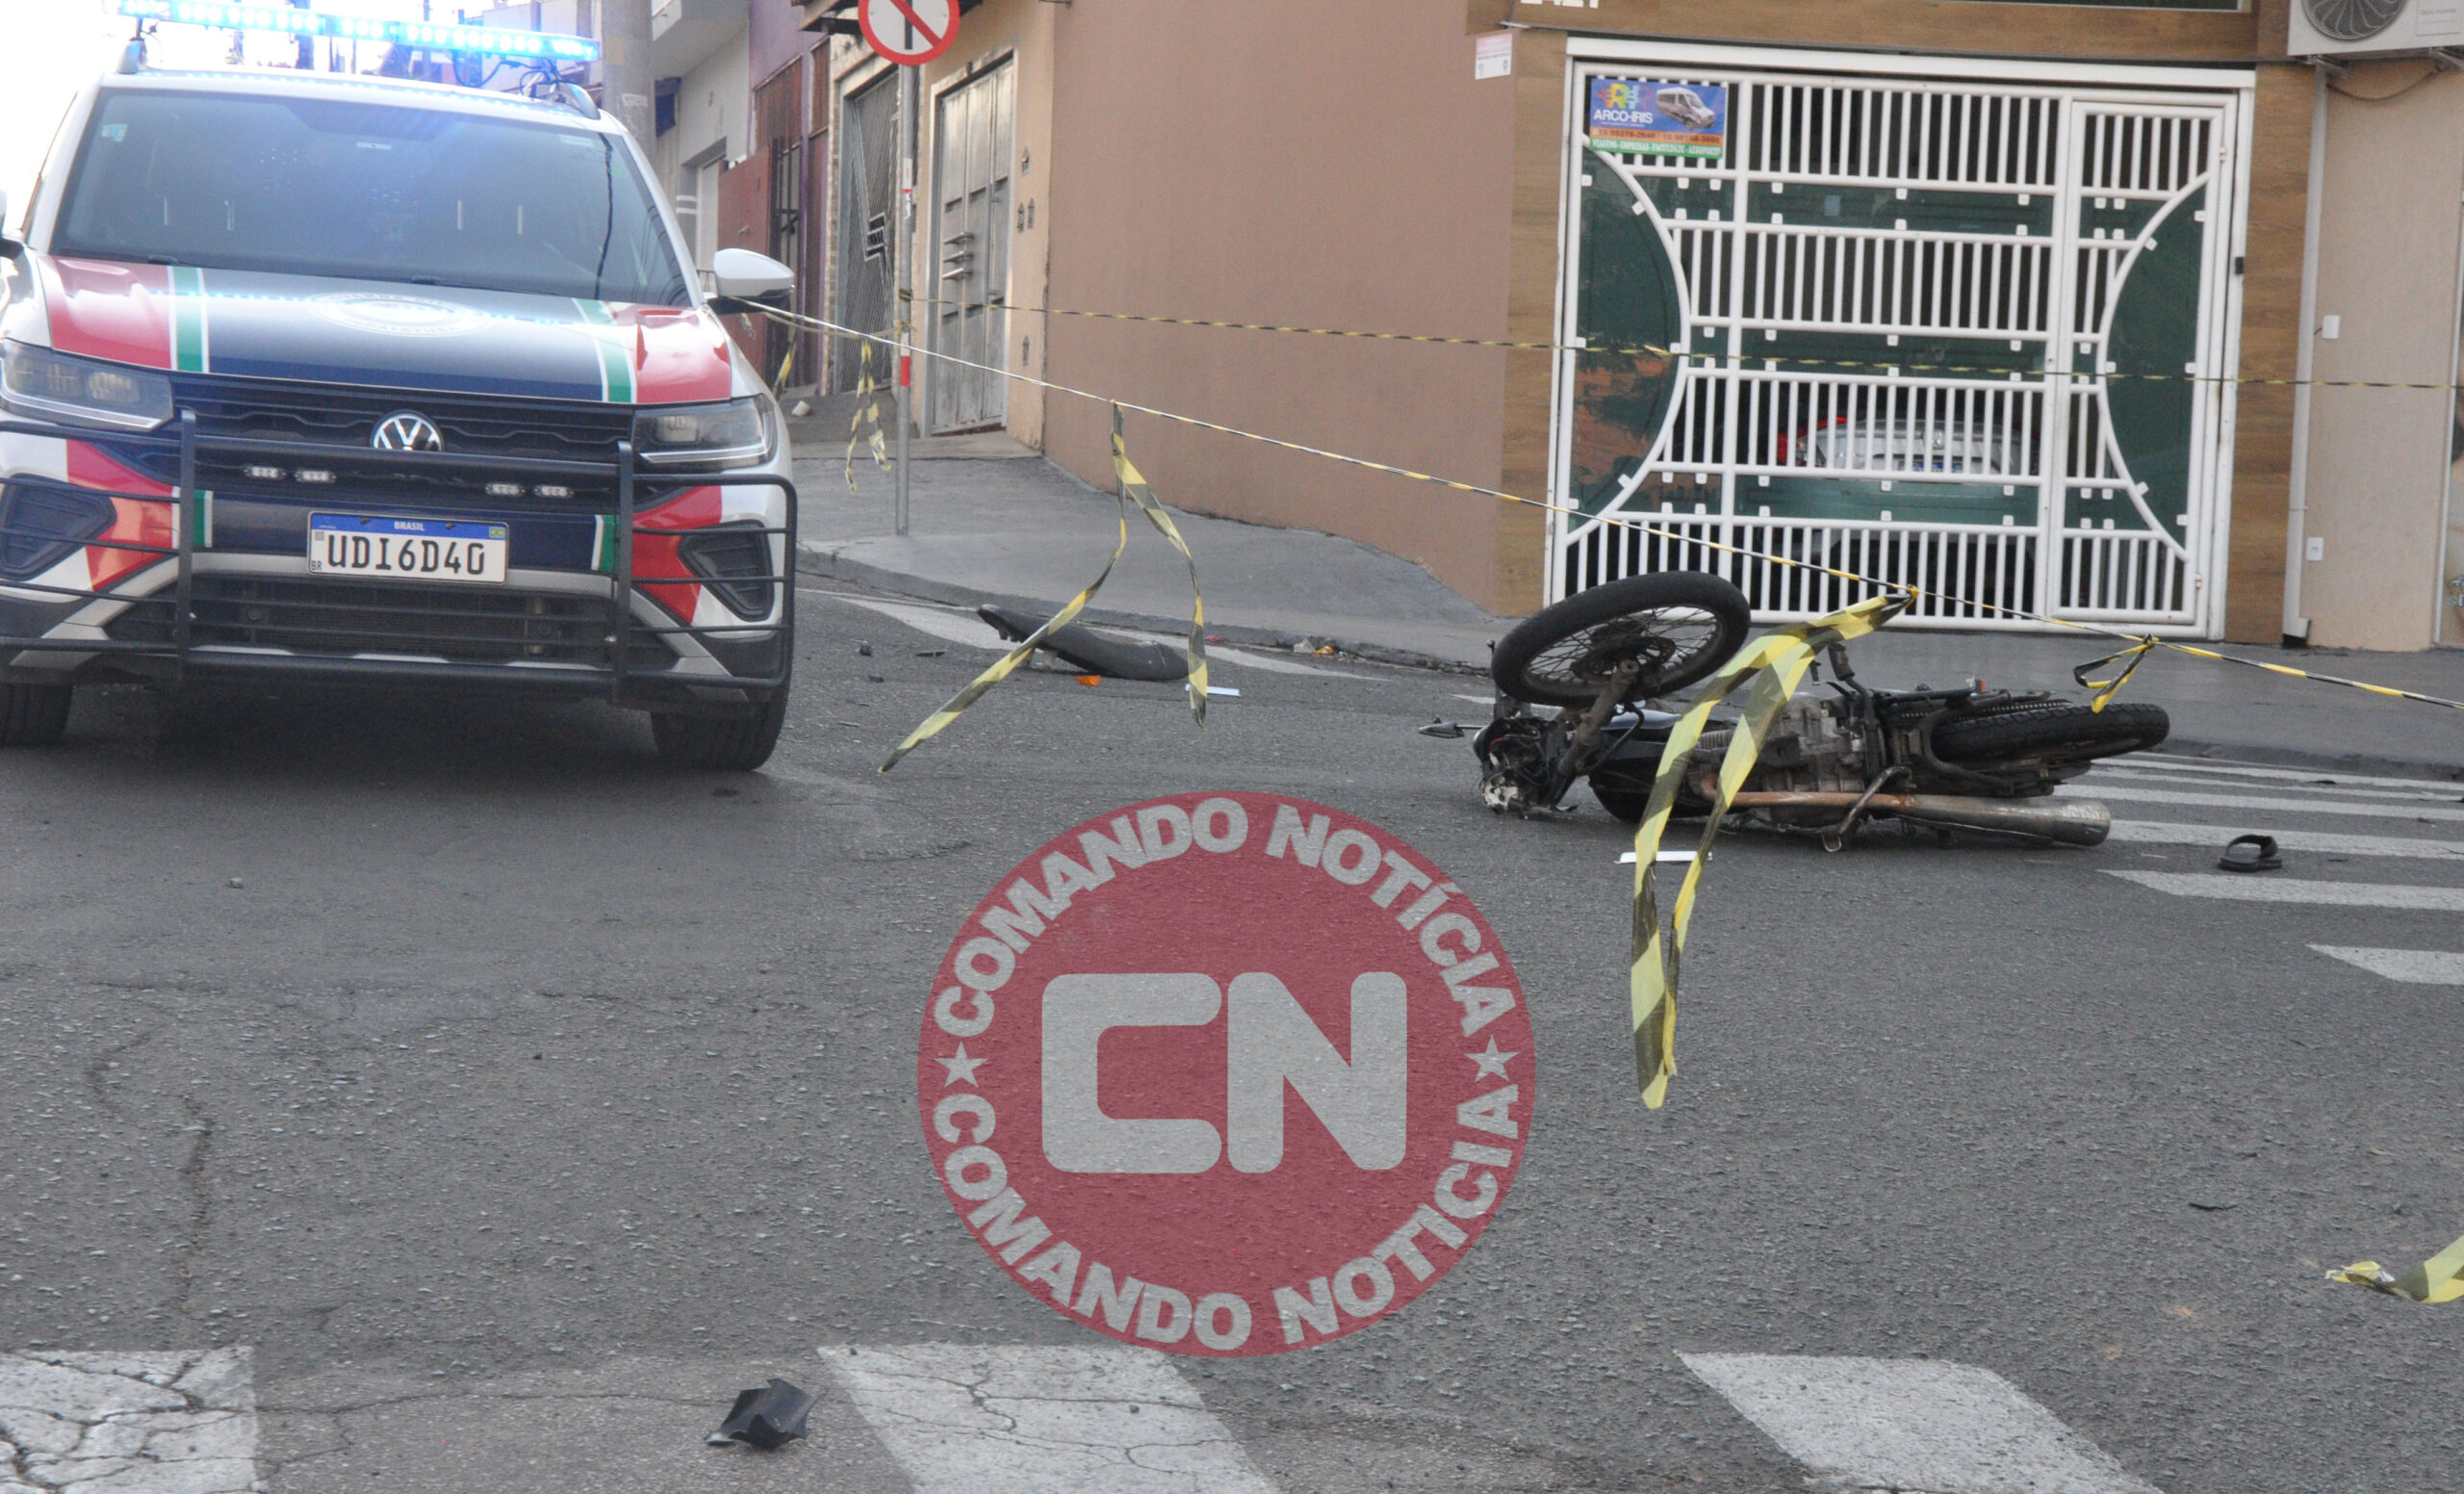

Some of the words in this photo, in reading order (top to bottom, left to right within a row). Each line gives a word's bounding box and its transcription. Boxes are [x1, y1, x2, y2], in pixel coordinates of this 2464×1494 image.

[1593, 108, 1654, 124] ARCO-IRIS
[394, 521, 425, 531] BRASIL
[327, 534, 485, 575] UDI6D40
[311, 559, 322, 571] BR
